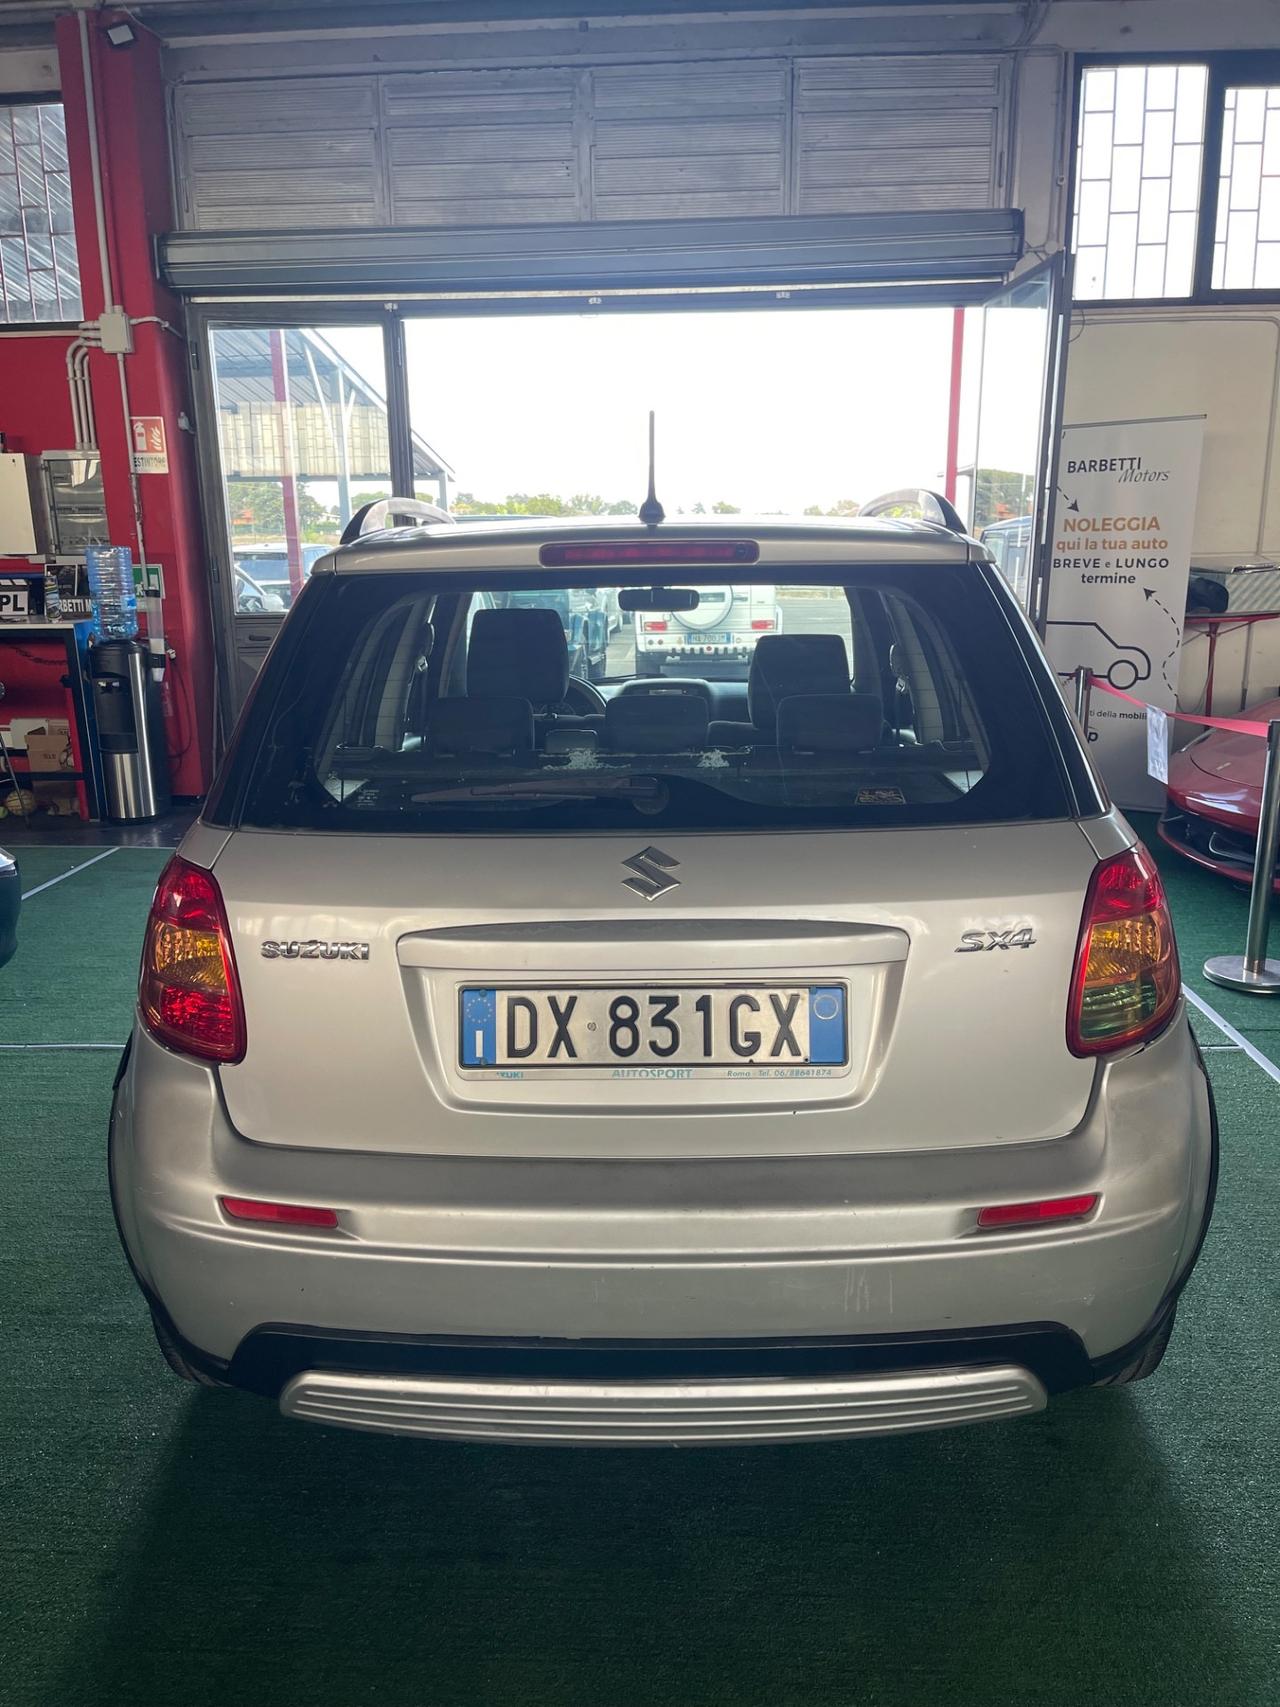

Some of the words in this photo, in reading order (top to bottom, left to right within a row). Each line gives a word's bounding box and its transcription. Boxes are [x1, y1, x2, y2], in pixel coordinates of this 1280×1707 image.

[1067, 457, 1141, 474] BARBETTI
[1118, 468, 1170, 483] Motors
[1063, 516, 1161, 532] NOLEGGIA
[1056, 538, 1081, 553] qui
[1084, 537, 1098, 550] la
[1102, 538, 1127, 550] tua
[1131, 537, 1168, 550] auto
[1053, 558, 1101, 569] BREVE
[1115, 558, 1169, 569] LUNGO
[1081, 572, 1136, 584] termine
[1096, 710, 1117, 719] della
[1119, 712, 1147, 721] mobili
[954, 928, 1036, 952] SX4
[260, 940, 369, 960] SUZUKI
[507, 995, 578, 1058] DX
[609, 994, 802, 1058] 831GX
[612, 1068, 692, 1078] AUTOSPORT
